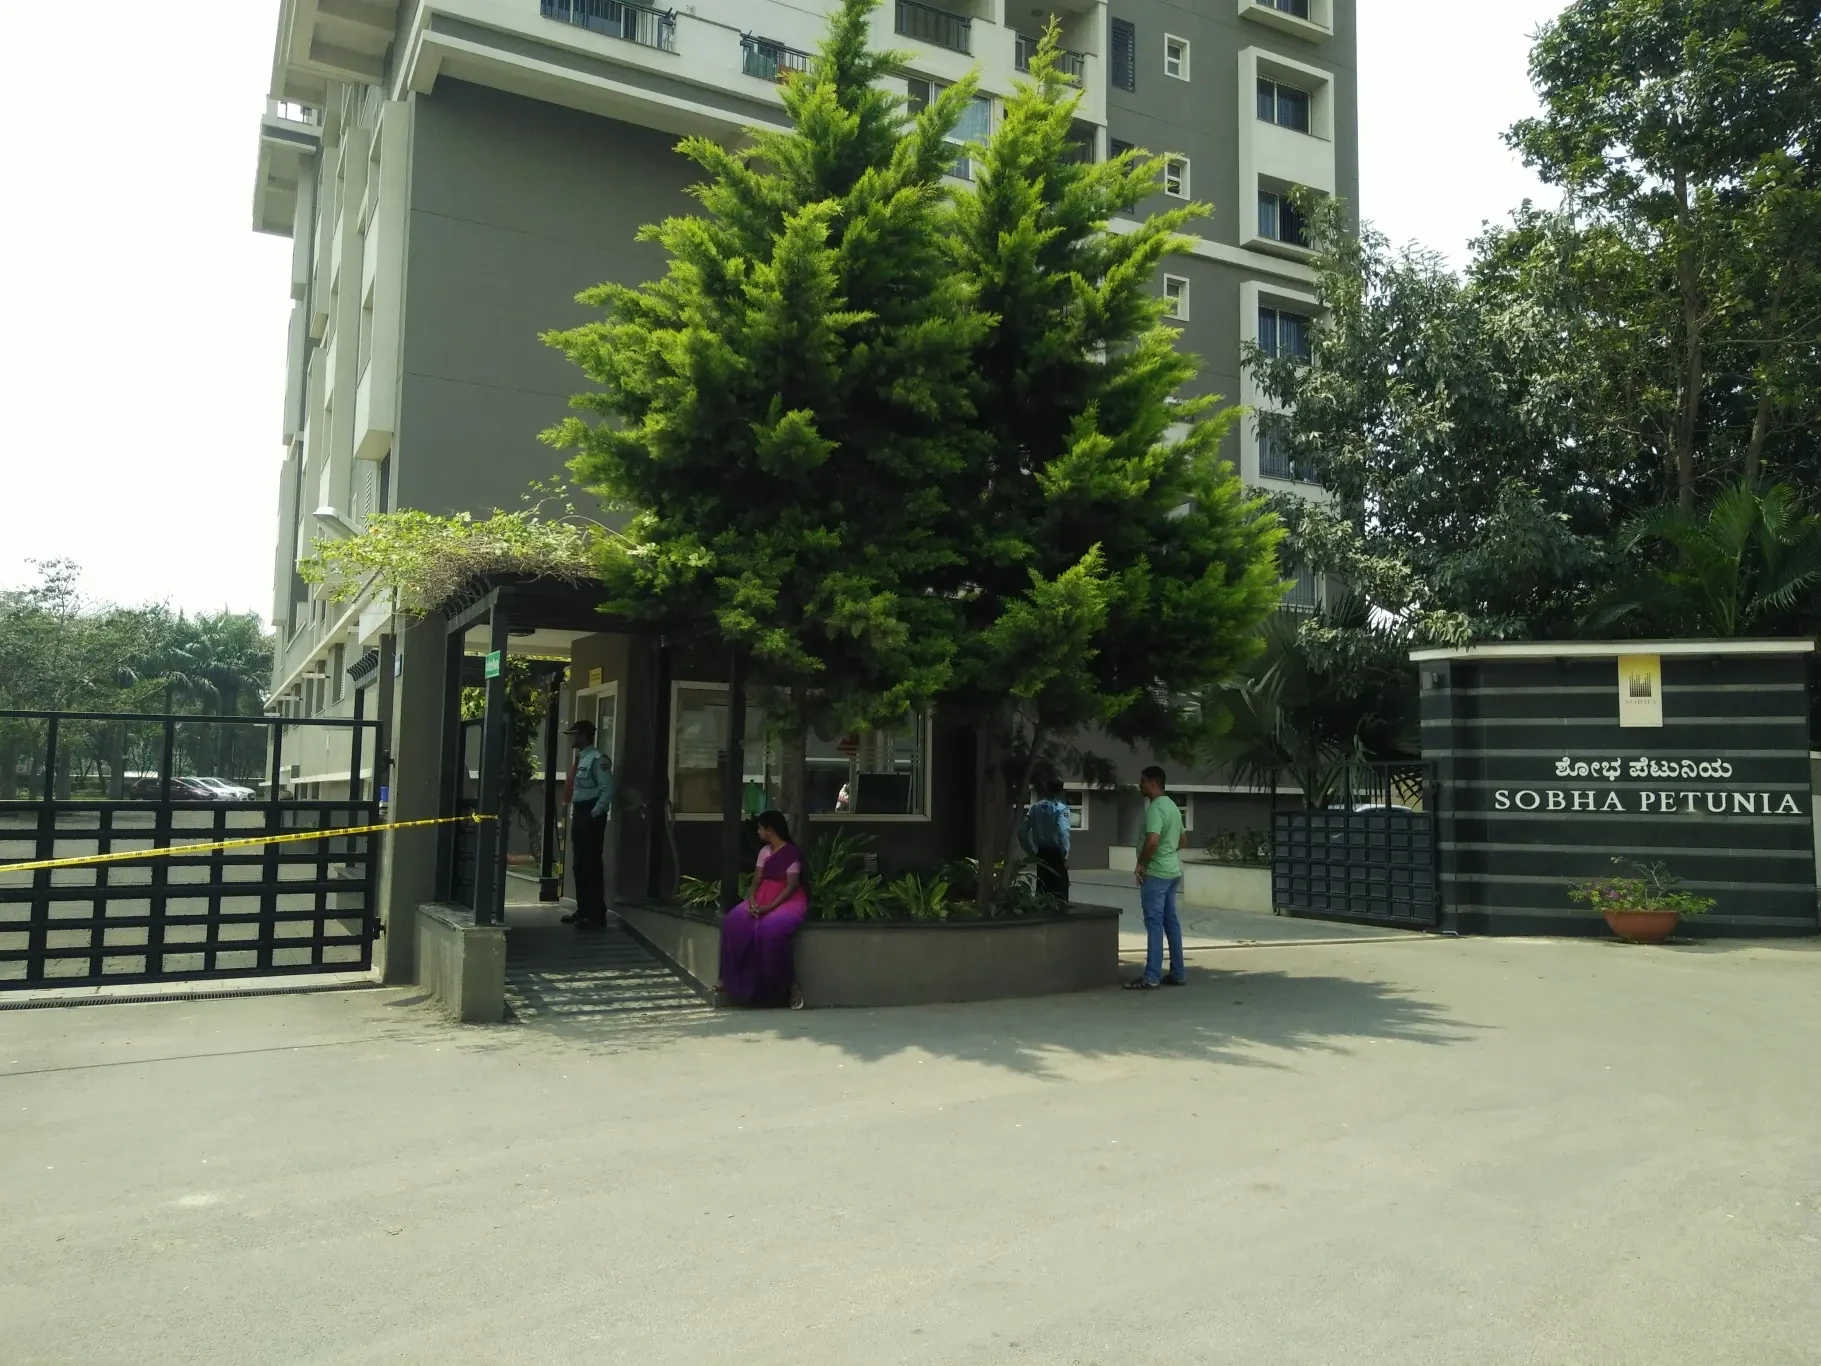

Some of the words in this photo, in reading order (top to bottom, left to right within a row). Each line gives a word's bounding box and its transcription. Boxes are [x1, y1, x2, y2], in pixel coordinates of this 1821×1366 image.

[1628, 756, 1733, 779] ಪೆಟುನಿಯ
[1494, 790, 1627, 811] SOBHA
[1639, 791, 1803, 814] PETUNIA
